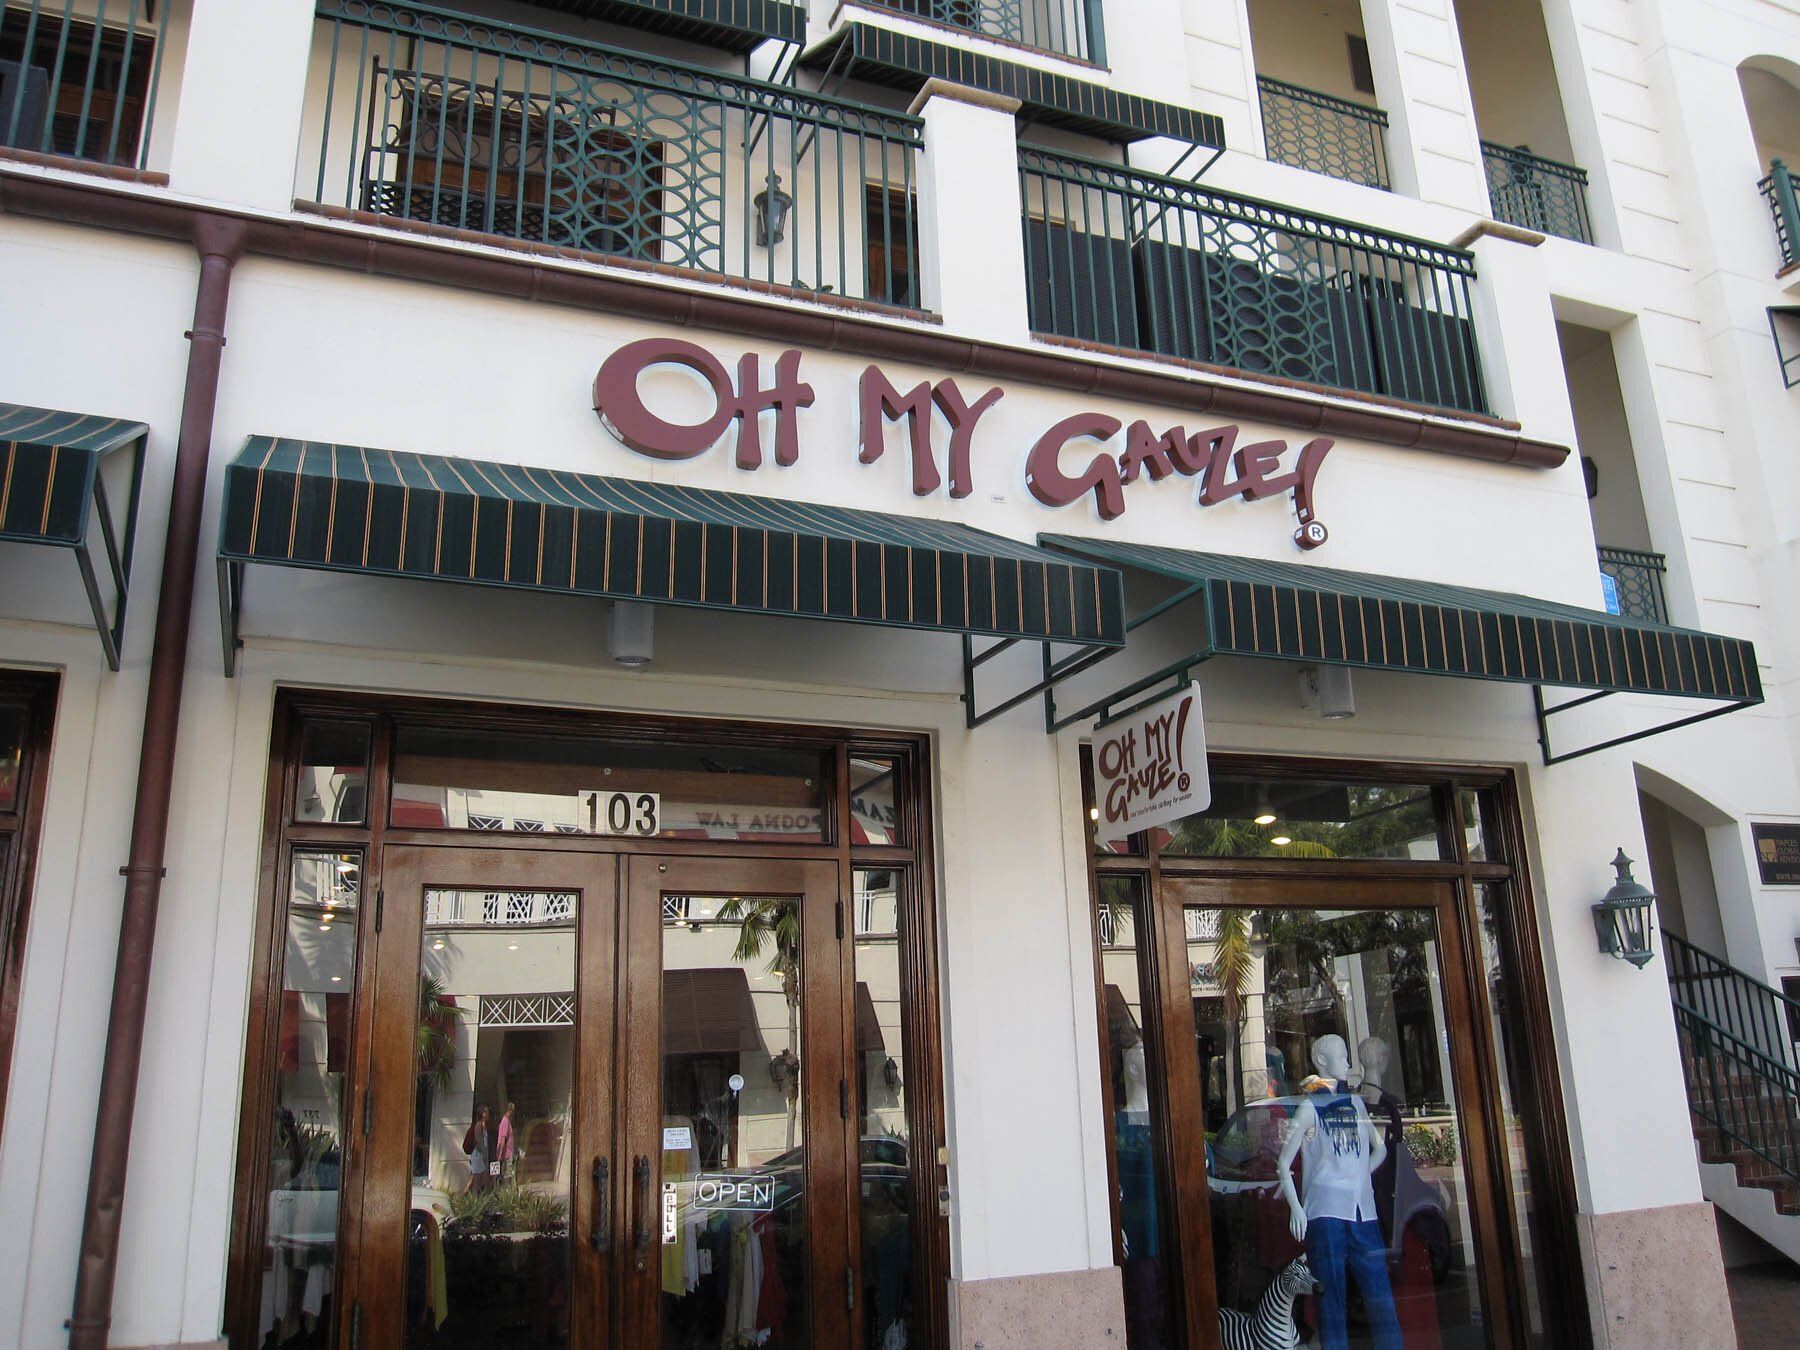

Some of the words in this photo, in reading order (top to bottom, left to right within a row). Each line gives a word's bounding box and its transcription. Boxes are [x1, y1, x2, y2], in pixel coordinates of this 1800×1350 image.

[592, 337, 815, 470] OH
[858, 364, 1004, 498] MY
[1099, 728, 1137, 780] OH
[585, 792, 657, 836] 103
[699, 1182, 769, 1203] OPEN
